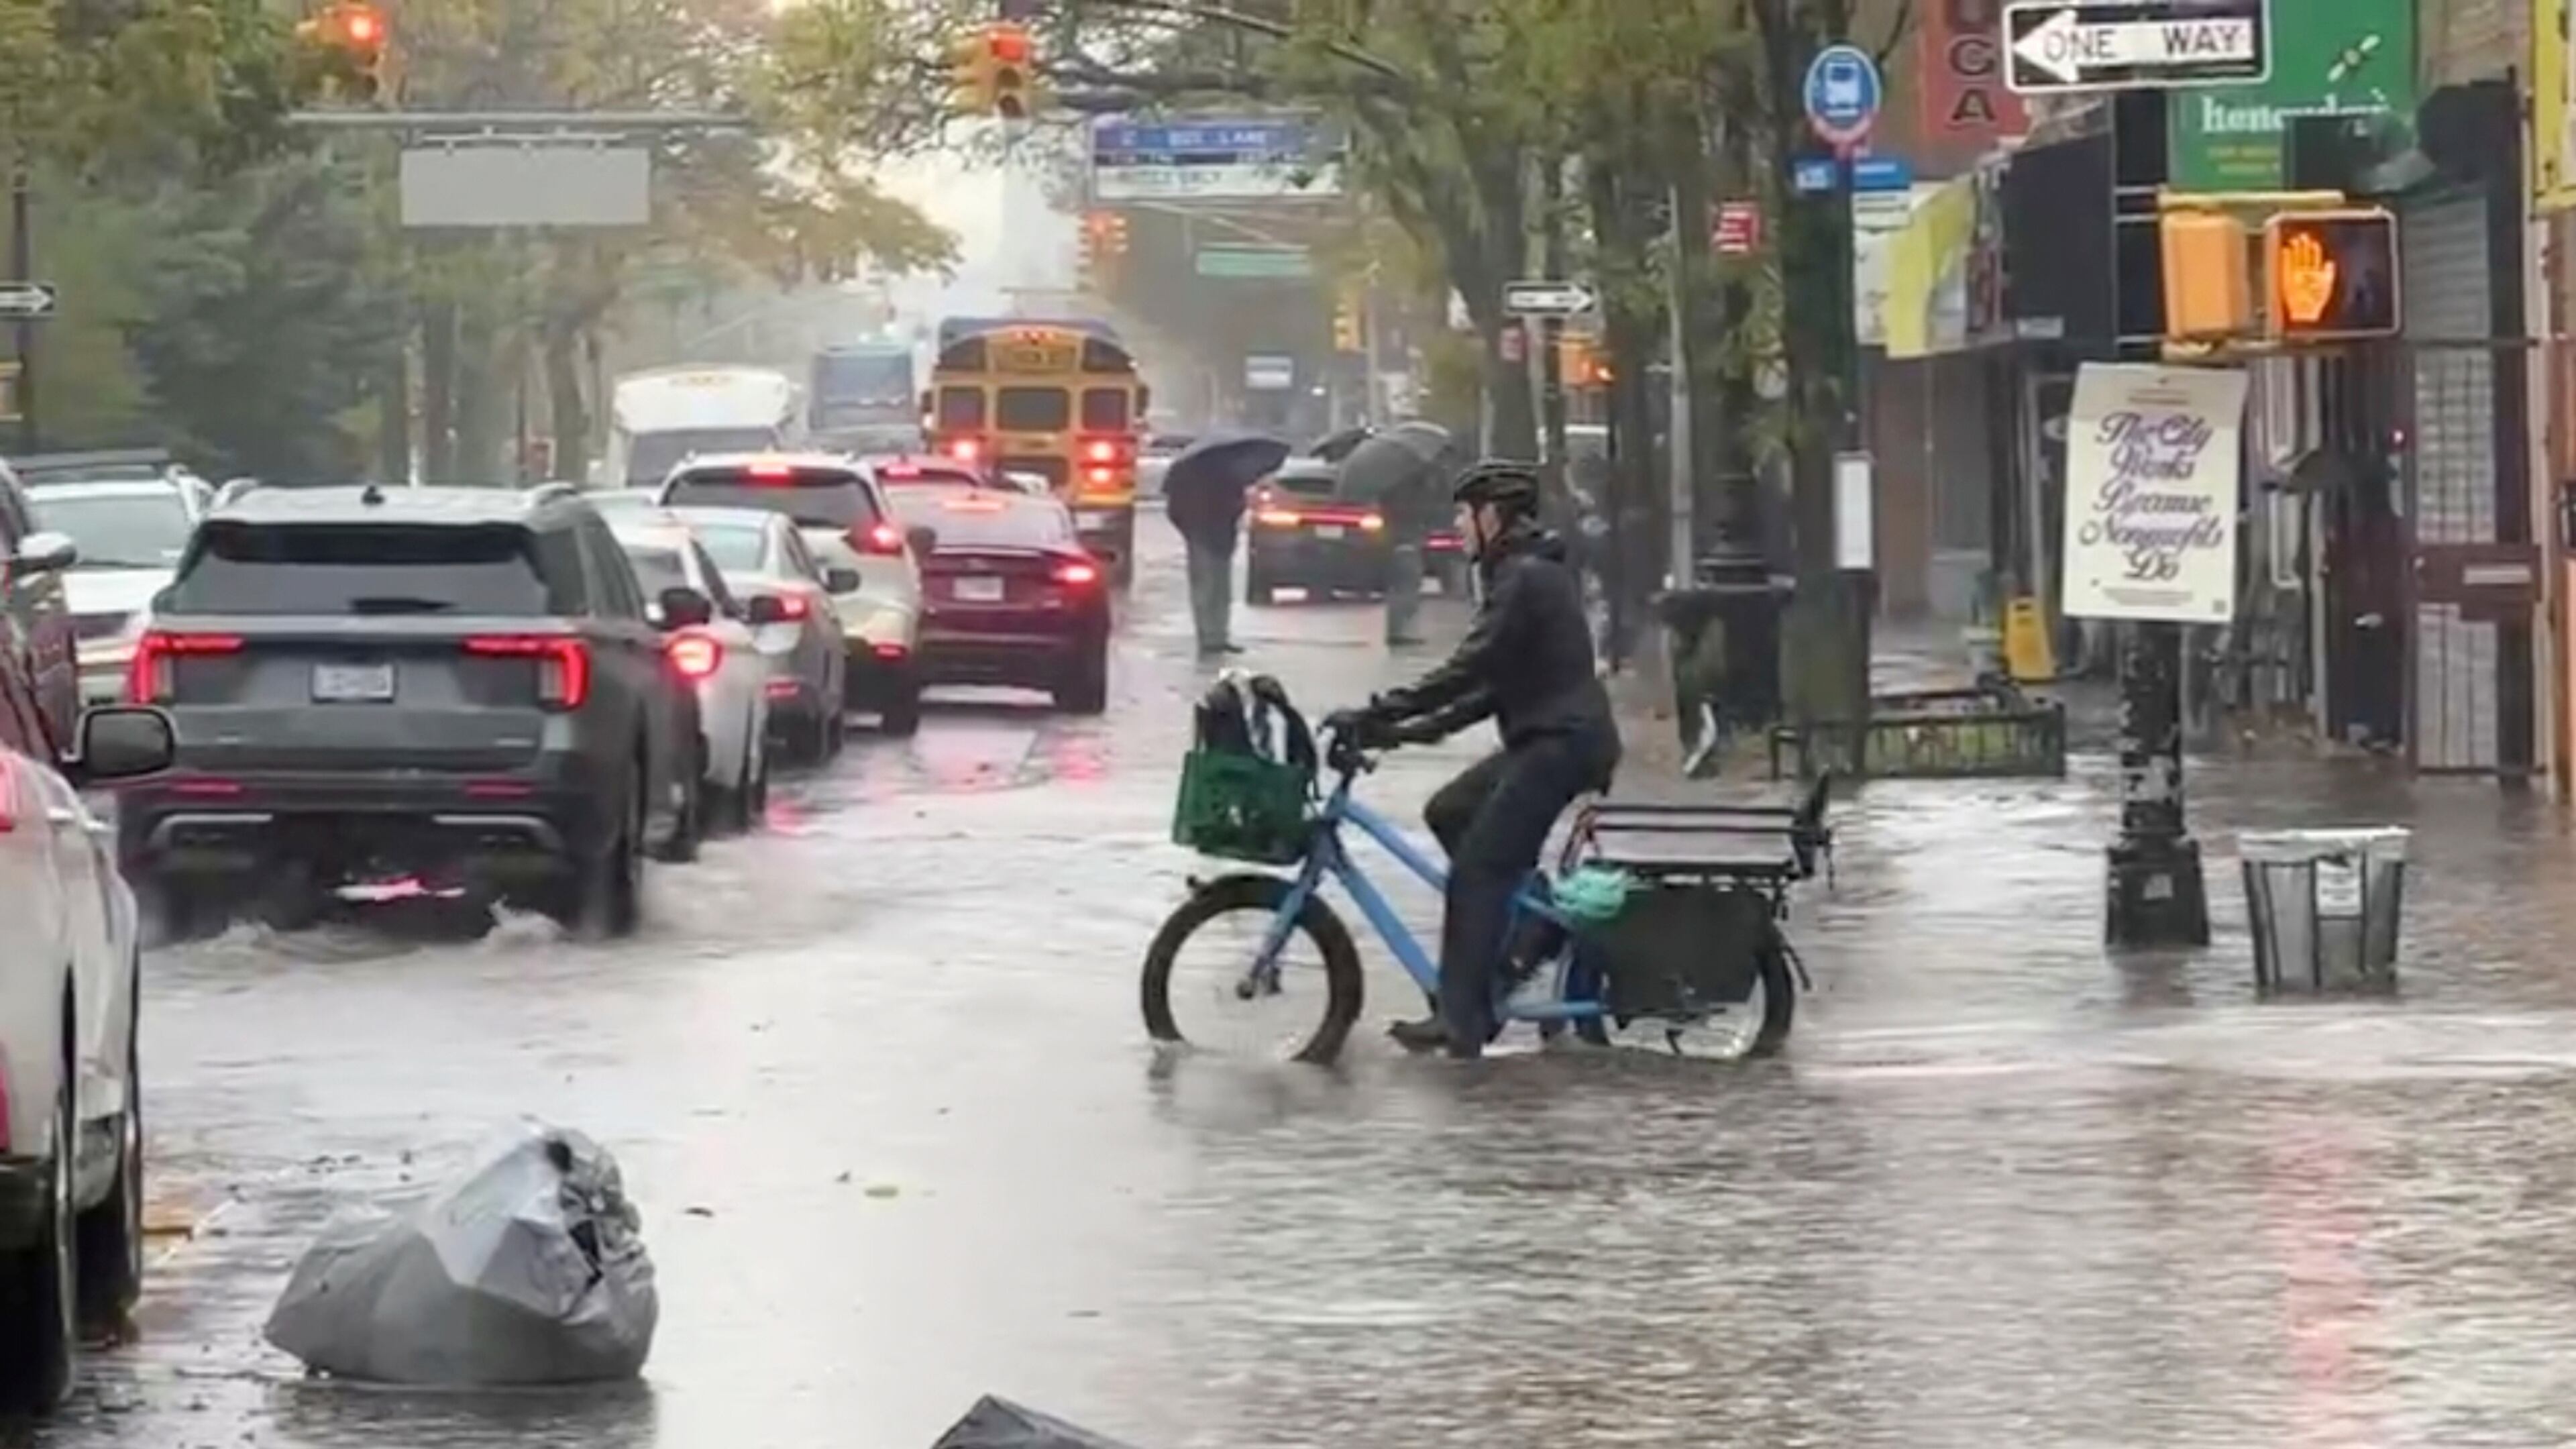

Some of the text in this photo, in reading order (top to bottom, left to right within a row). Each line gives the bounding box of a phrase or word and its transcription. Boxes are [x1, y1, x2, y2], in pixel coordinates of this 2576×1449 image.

[2043, 24, 2241, 61] ONE WAY
[2094, 411, 2213, 455] The City
[2110, 444, 2195, 480] Works
[2092, 479, 2214, 515] Because
[2122, 548, 2180, 582] Do
